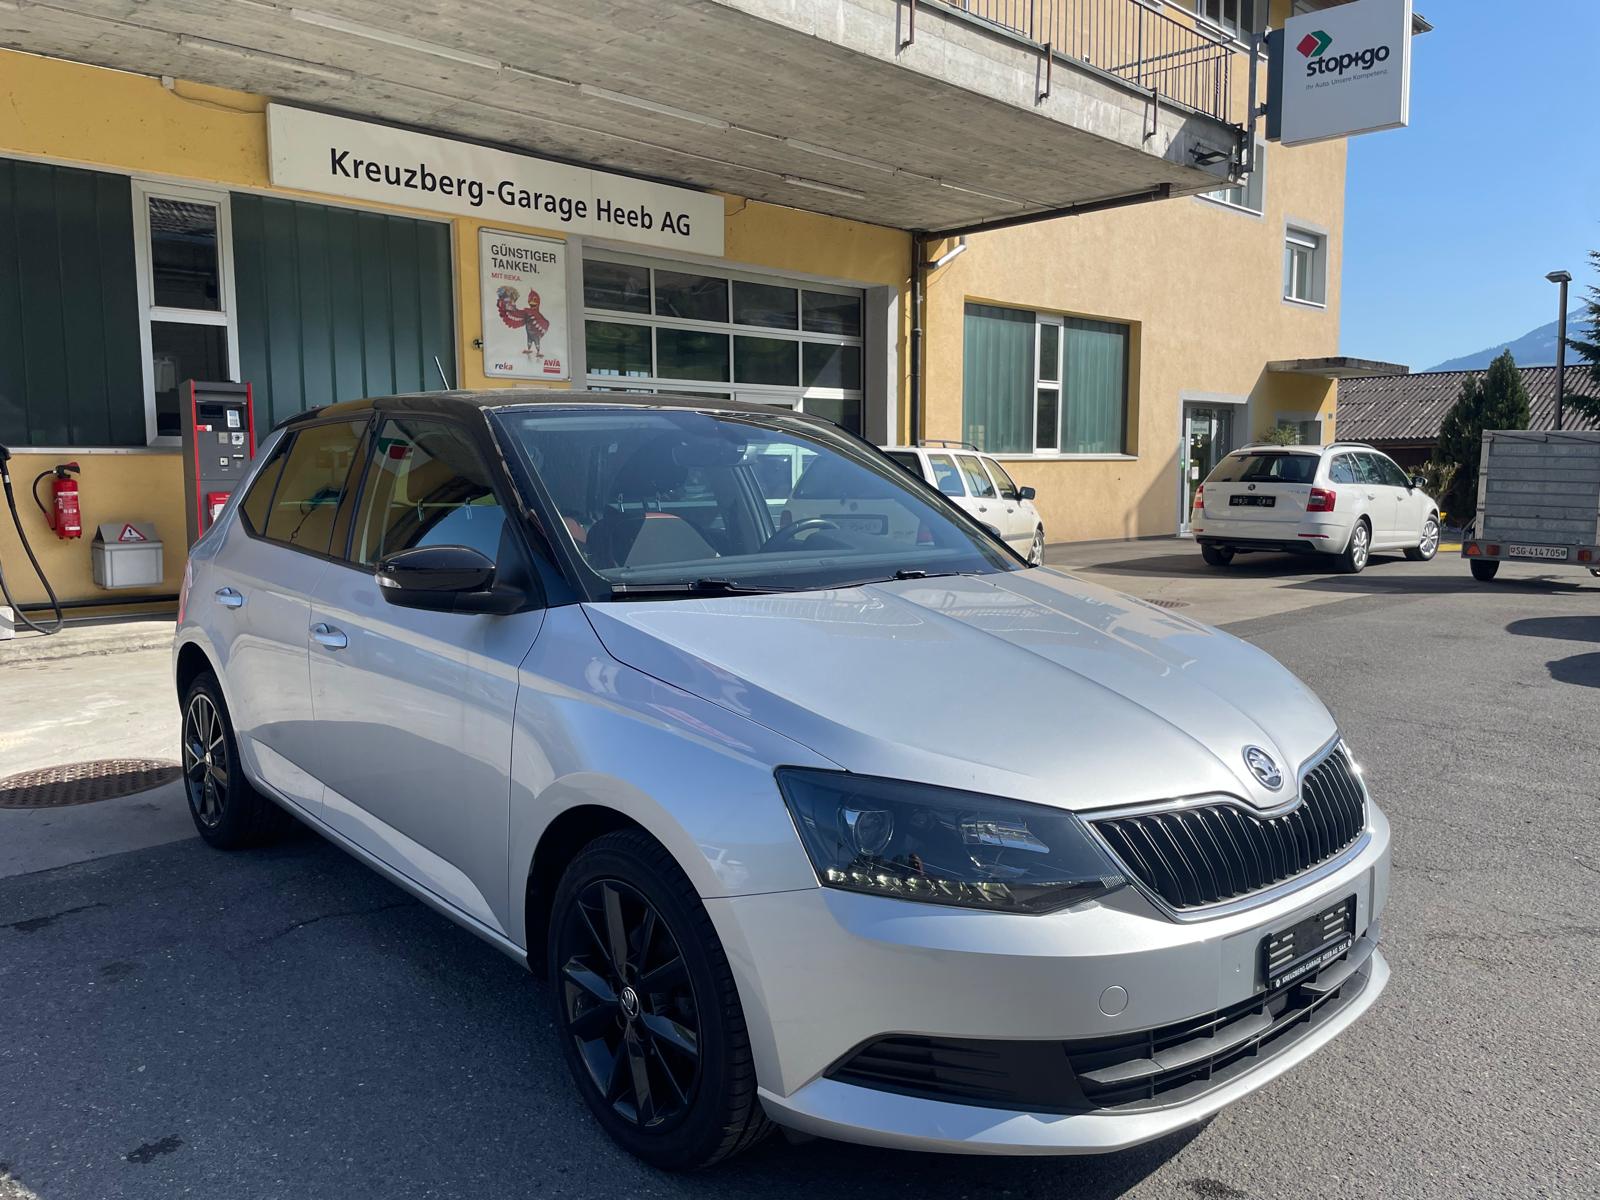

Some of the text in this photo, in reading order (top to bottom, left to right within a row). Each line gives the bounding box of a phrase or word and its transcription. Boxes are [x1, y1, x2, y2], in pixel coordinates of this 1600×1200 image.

[1306, 45, 1390, 77] stop+go
[1331, 76, 1353, 85] Unsere
[330, 148, 690, 236] Kreuzberg-Garage Heeb AG
[491, 243, 557, 264] GÜNSTIGER
[491, 257, 540, 274] TANKEN.
[495, 361, 513, 371] reka
[543, 359, 560, 367] AVIA
